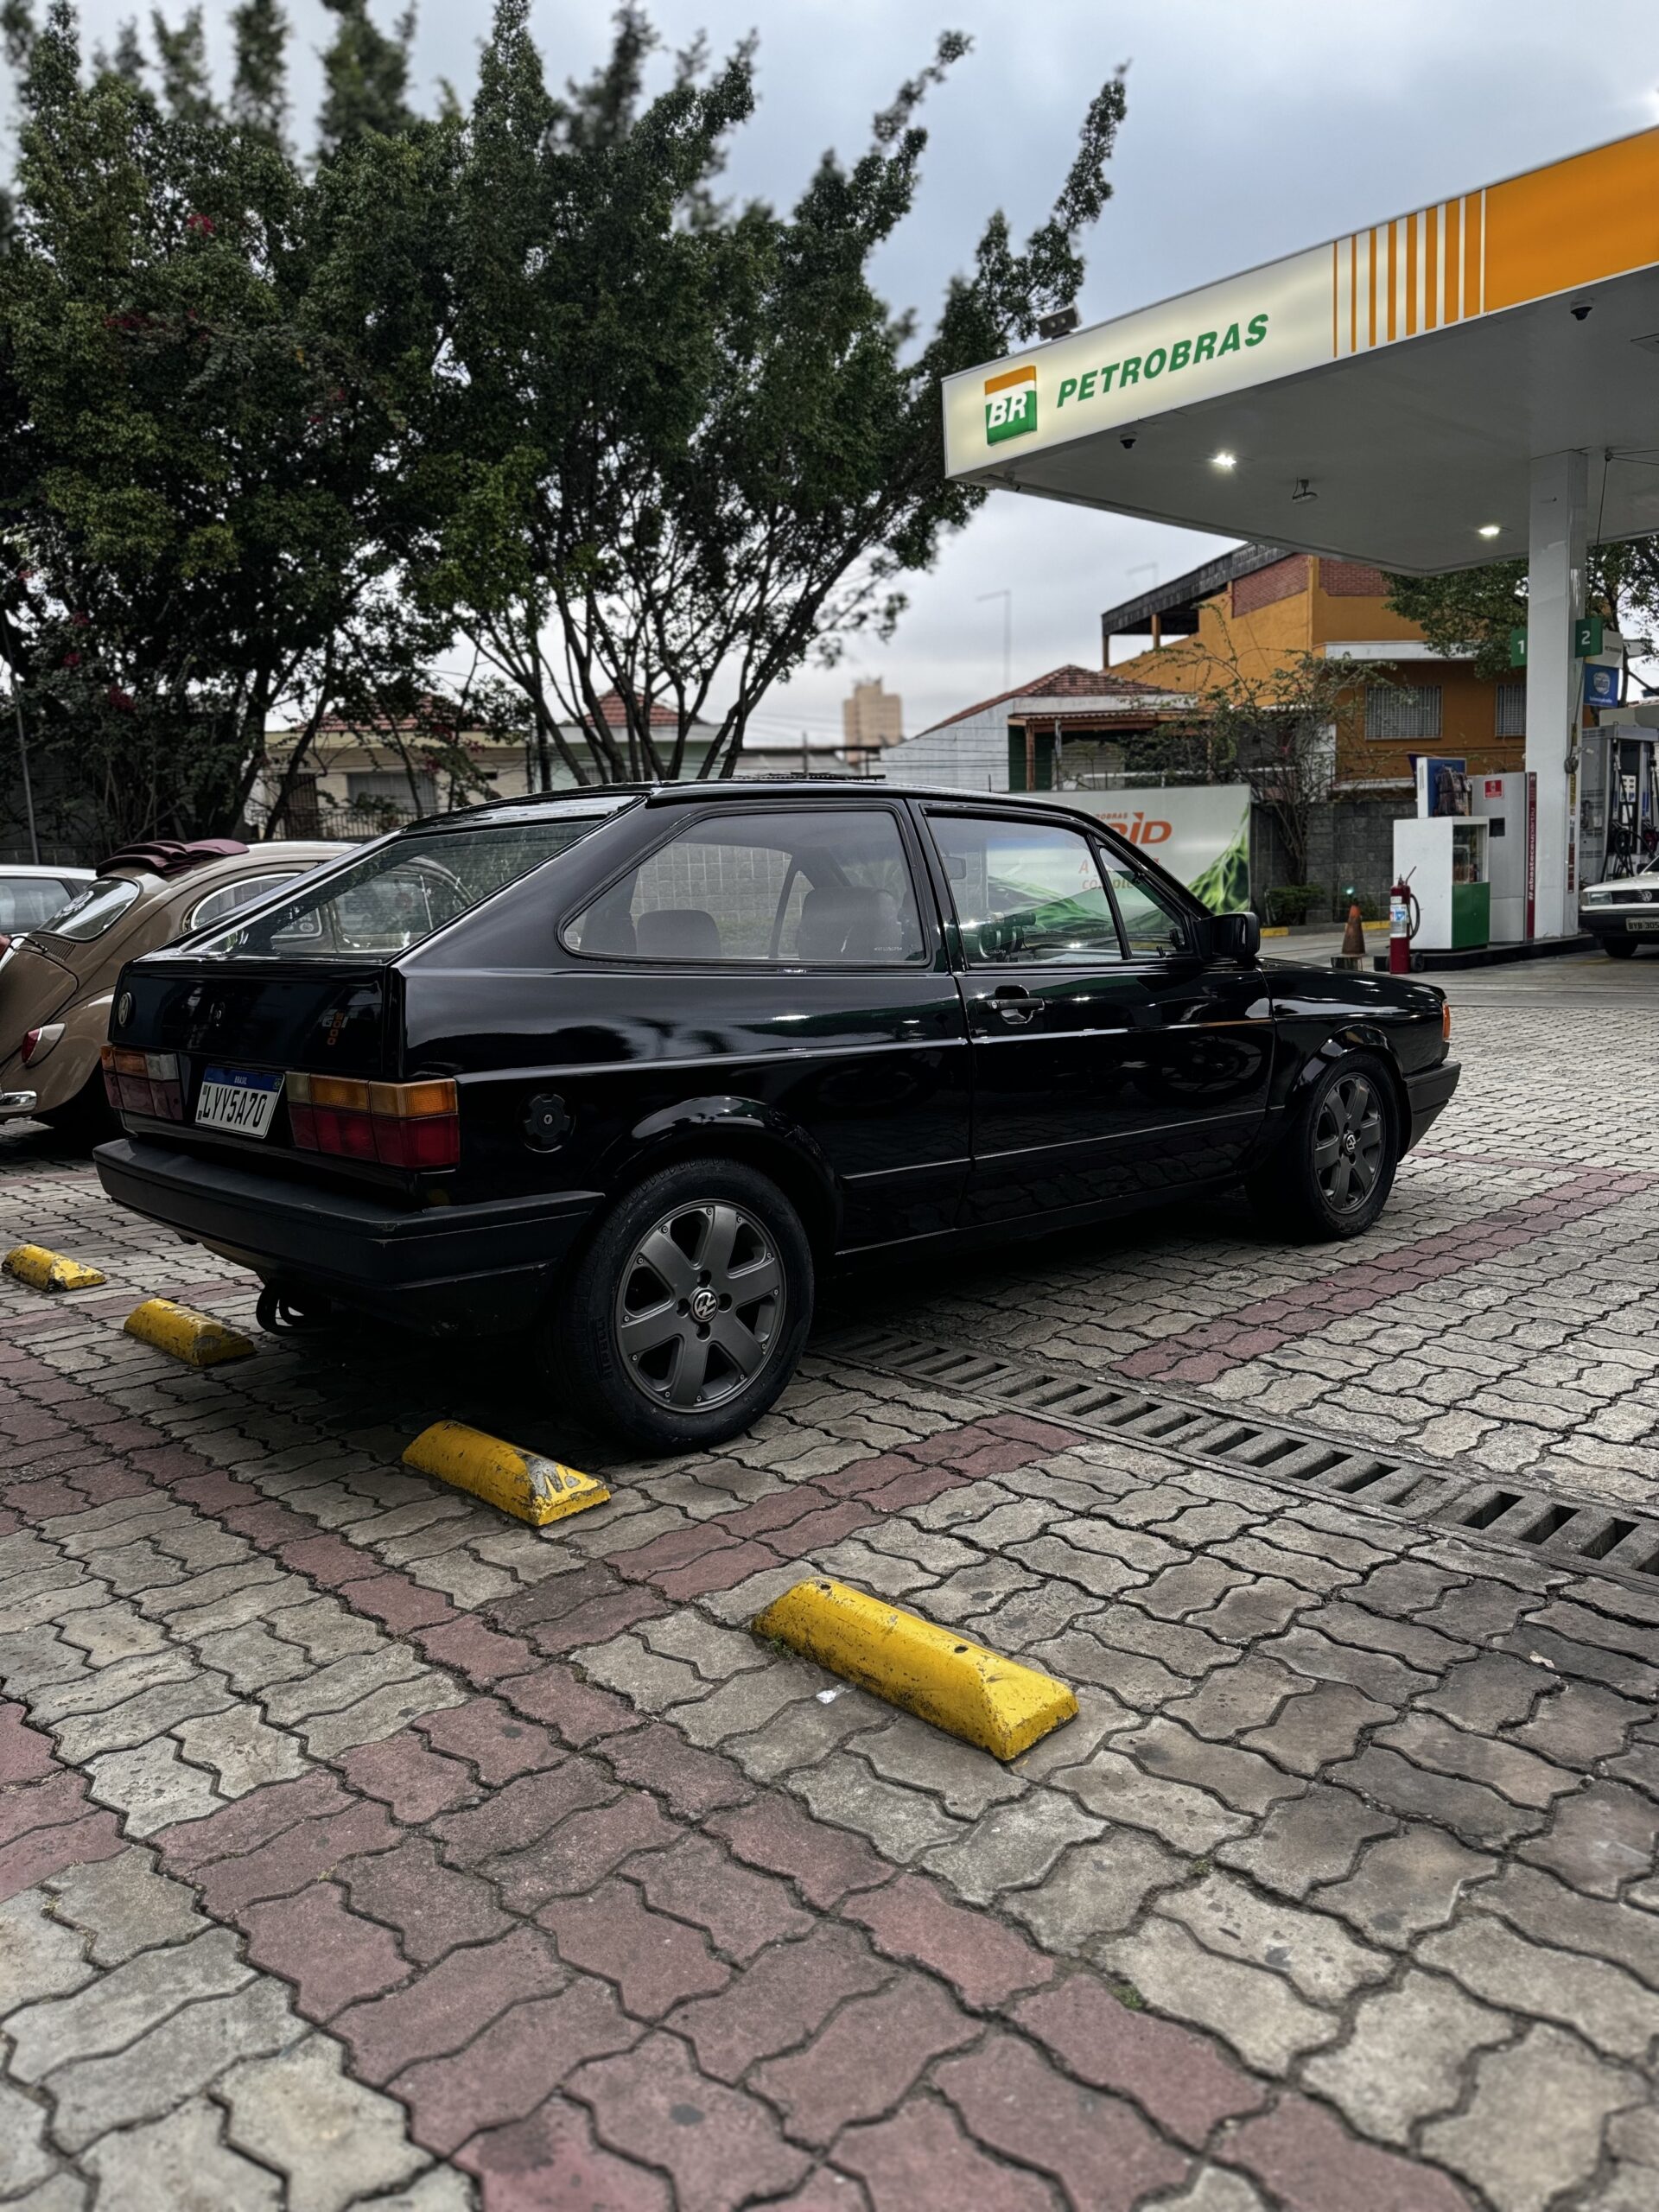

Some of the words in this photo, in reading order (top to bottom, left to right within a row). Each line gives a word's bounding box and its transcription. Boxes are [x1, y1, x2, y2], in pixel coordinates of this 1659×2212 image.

[1056, 314, 1269, 408] PETROBRAS
[988, 391, 1028, 429] BR
[1517, 639, 1525, 654] 1
[1581, 630, 1591, 645] 2
[202, 1085, 268, 1128] LYY5A70
